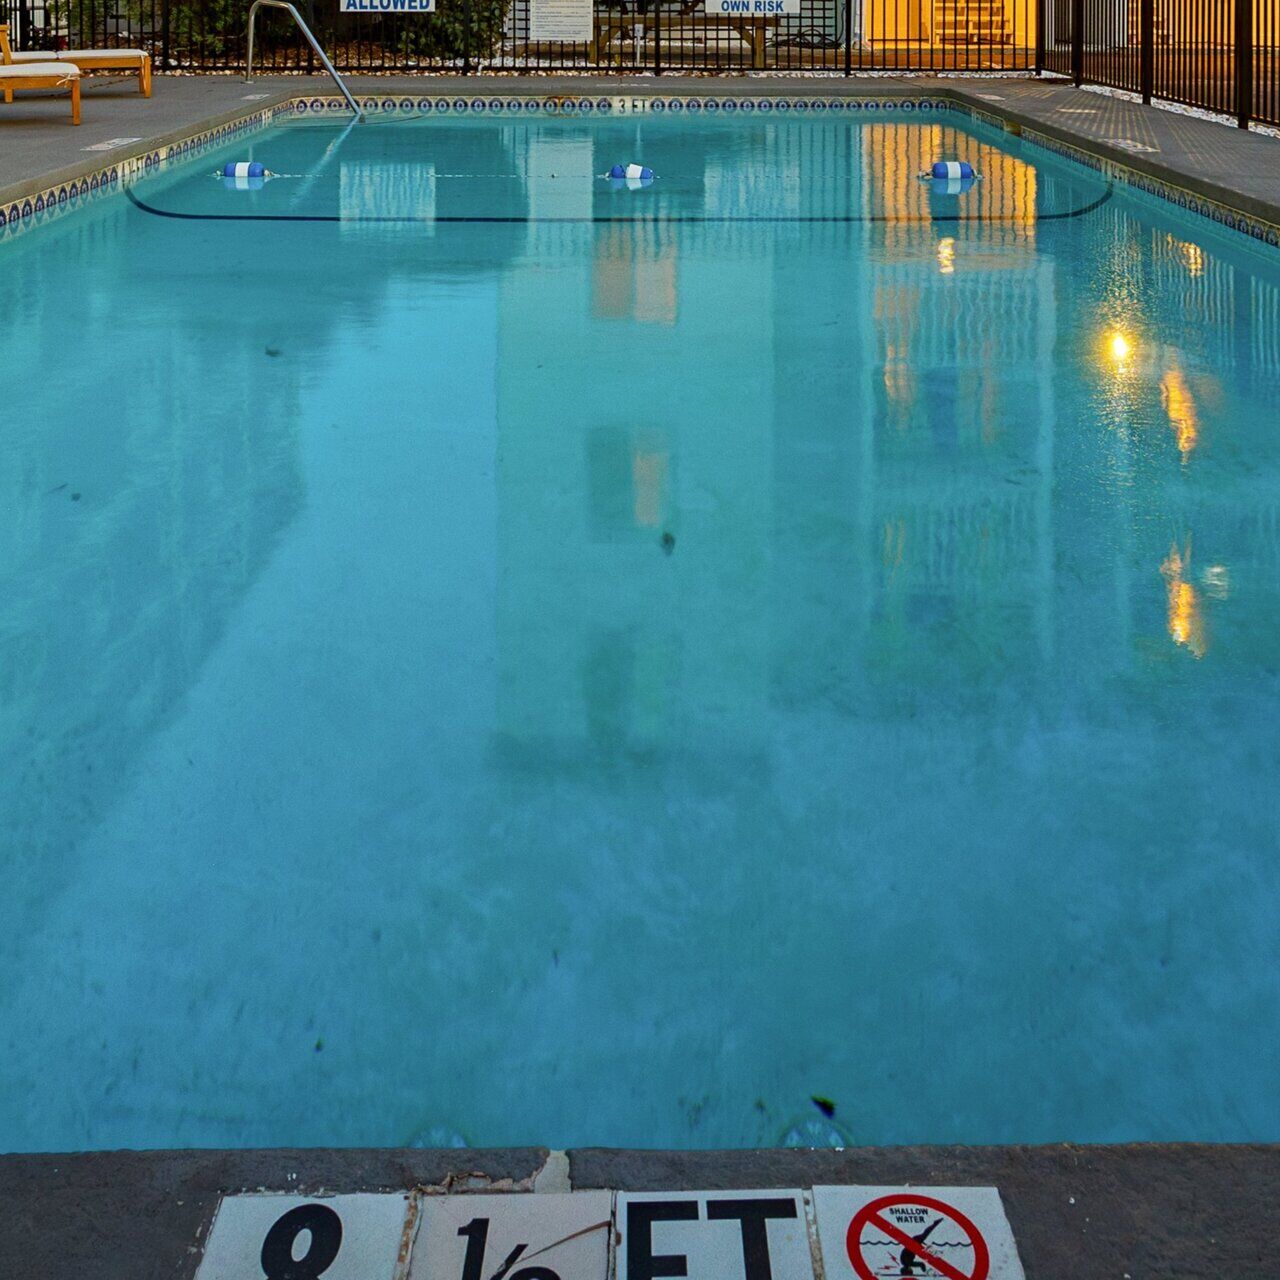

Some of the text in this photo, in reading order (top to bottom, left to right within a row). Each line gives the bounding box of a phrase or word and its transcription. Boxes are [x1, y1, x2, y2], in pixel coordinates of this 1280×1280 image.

[721, 0, 784, 12] OWN RISK
[888, 1207, 929, 1216] SHALLOW
[895, 1215, 926, 1224] WATER
[457, 1217, 562, 1280] 1/
[627, 1197, 797, 1280] FT
